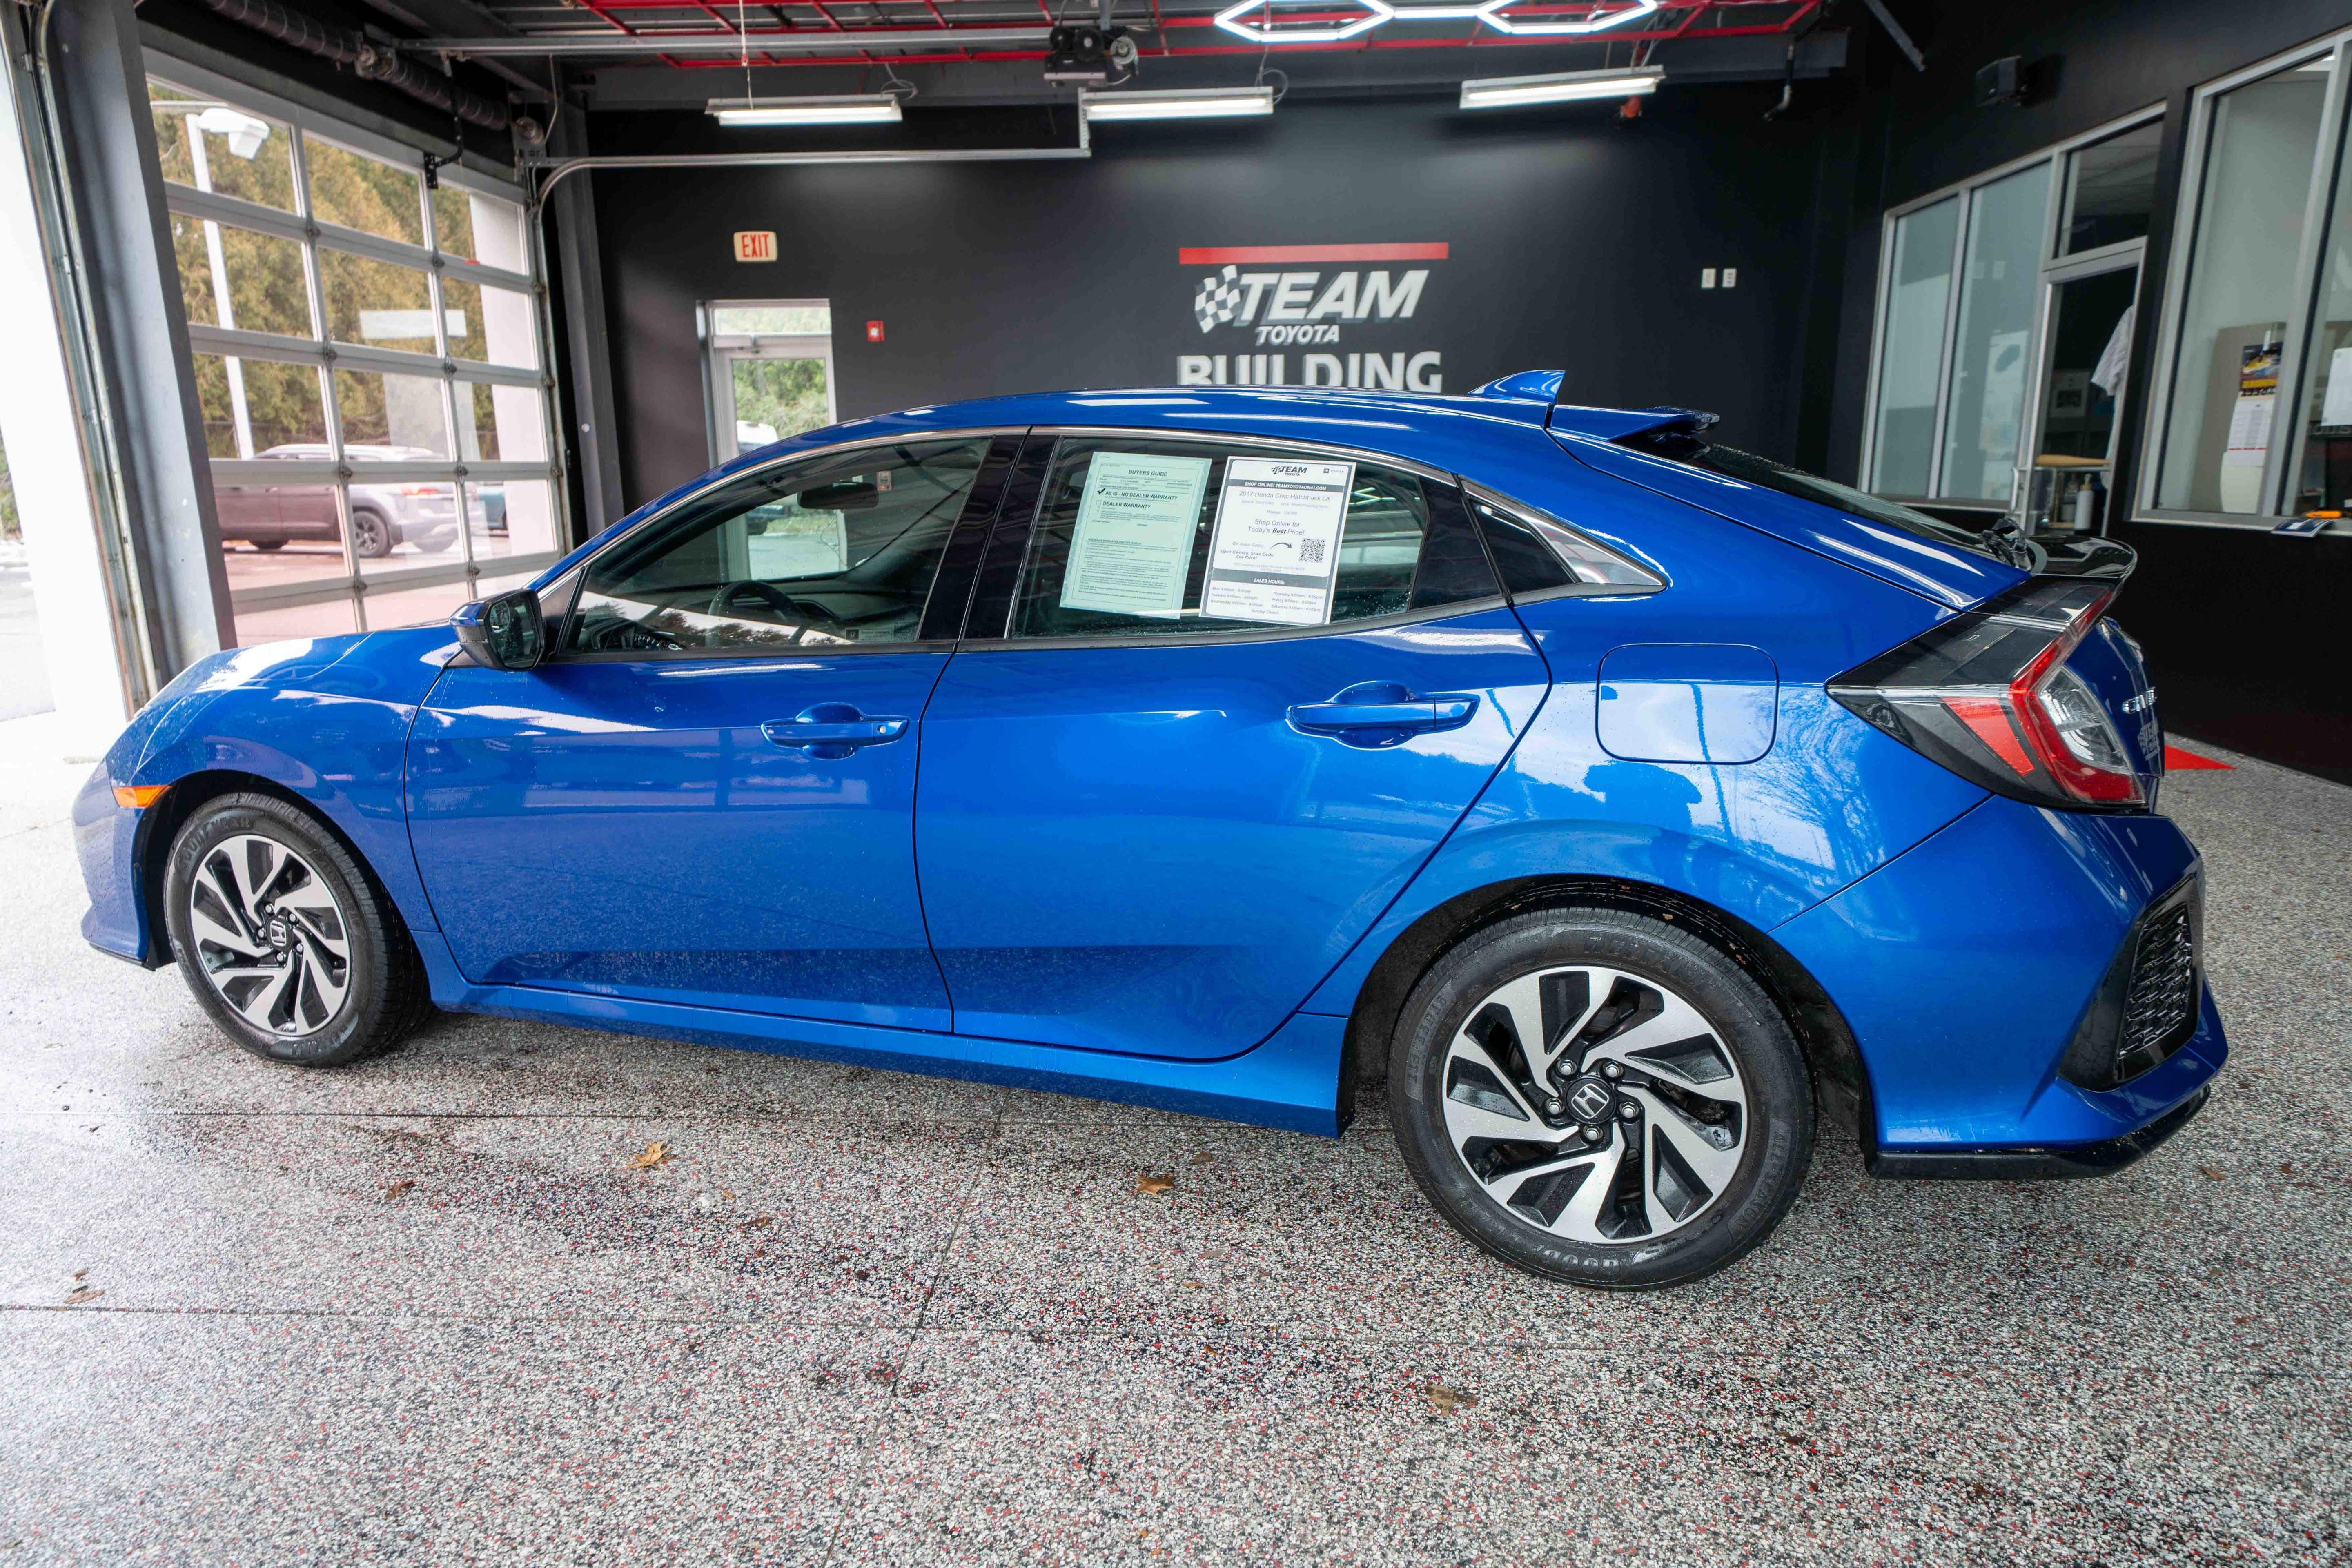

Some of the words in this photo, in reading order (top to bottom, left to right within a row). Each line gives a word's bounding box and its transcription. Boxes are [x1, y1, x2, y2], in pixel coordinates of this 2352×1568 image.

[741, 234, 769, 258] EXIT
[1235, 270, 1430, 325] TEAM
[1256, 325, 1339, 345] TOYOTA
